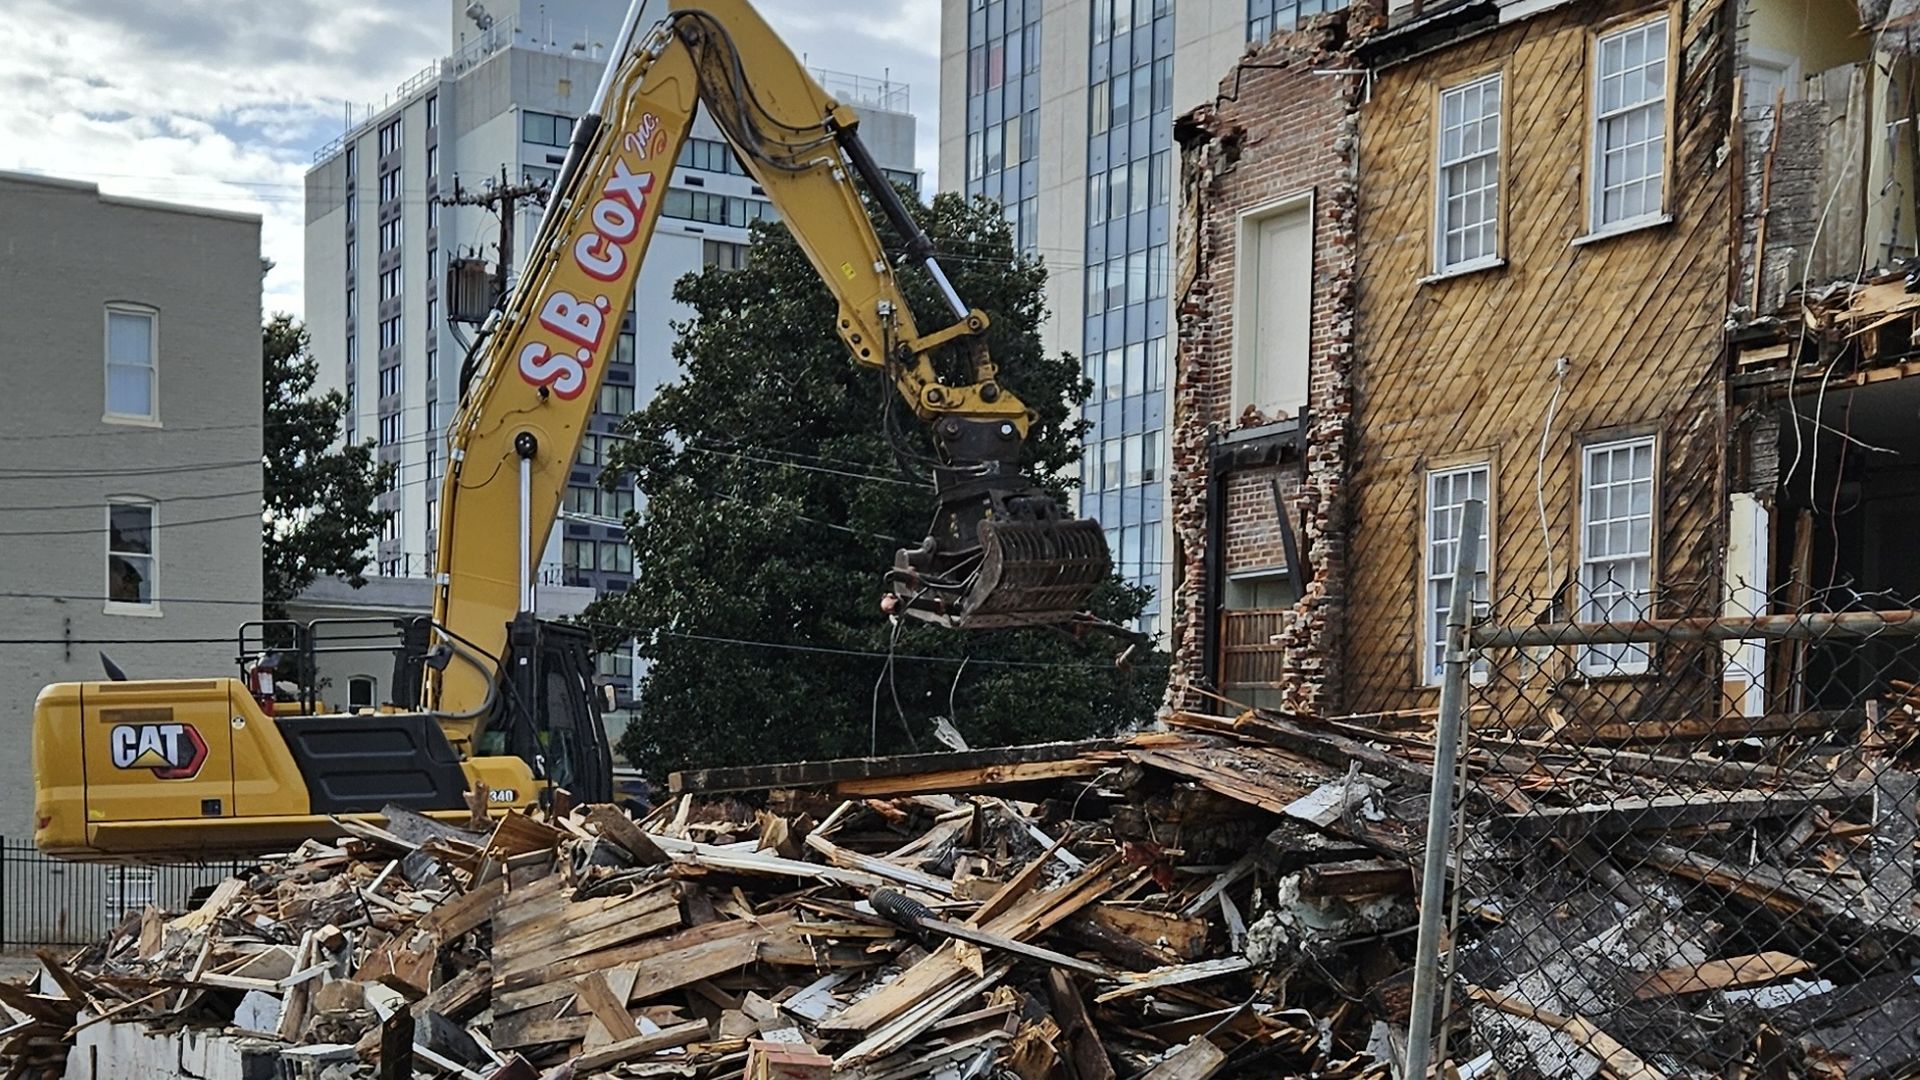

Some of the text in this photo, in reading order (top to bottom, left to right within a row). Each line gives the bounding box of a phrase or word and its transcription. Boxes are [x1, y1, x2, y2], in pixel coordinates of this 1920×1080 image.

[519, 291, 611, 400] S.B.
[575, 156, 655, 282] COX
[112, 724, 184, 768] CAT
[489, 790, 514, 802] 340
